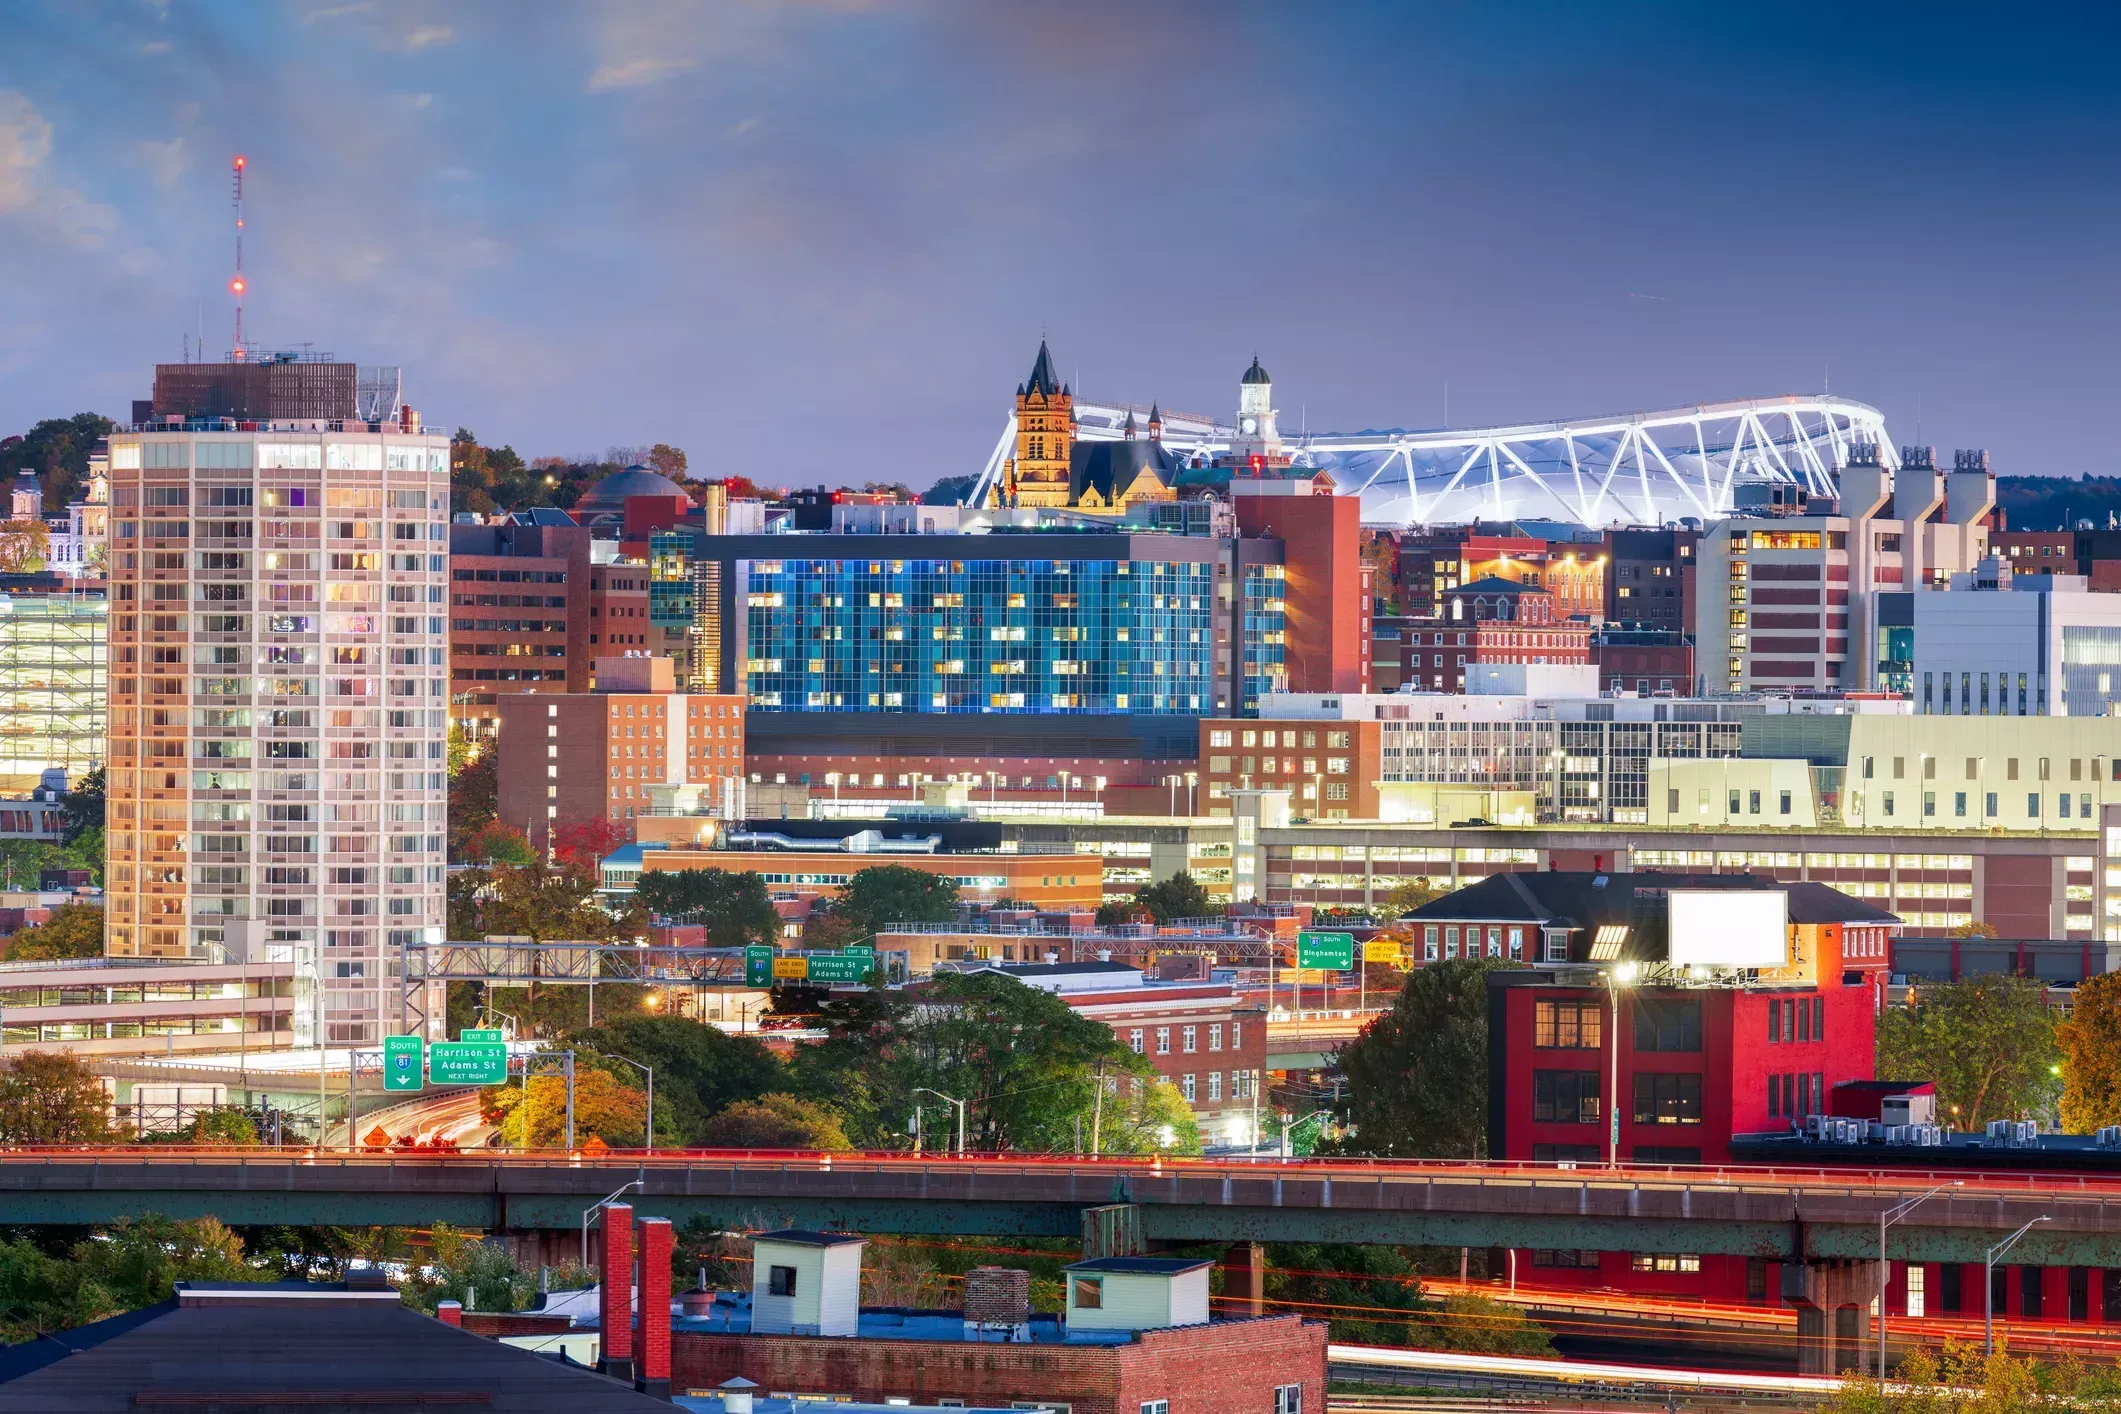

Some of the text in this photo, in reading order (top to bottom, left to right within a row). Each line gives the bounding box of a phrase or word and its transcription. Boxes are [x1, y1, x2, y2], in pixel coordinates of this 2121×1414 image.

[486, 1033, 496, 1041] 18
[390, 1042, 418, 1050] SOUTH
[436, 1049, 500, 1057] Harrison St
[398, 1058, 408, 1066] 81
[442, 1062, 496, 1070] Adams St
